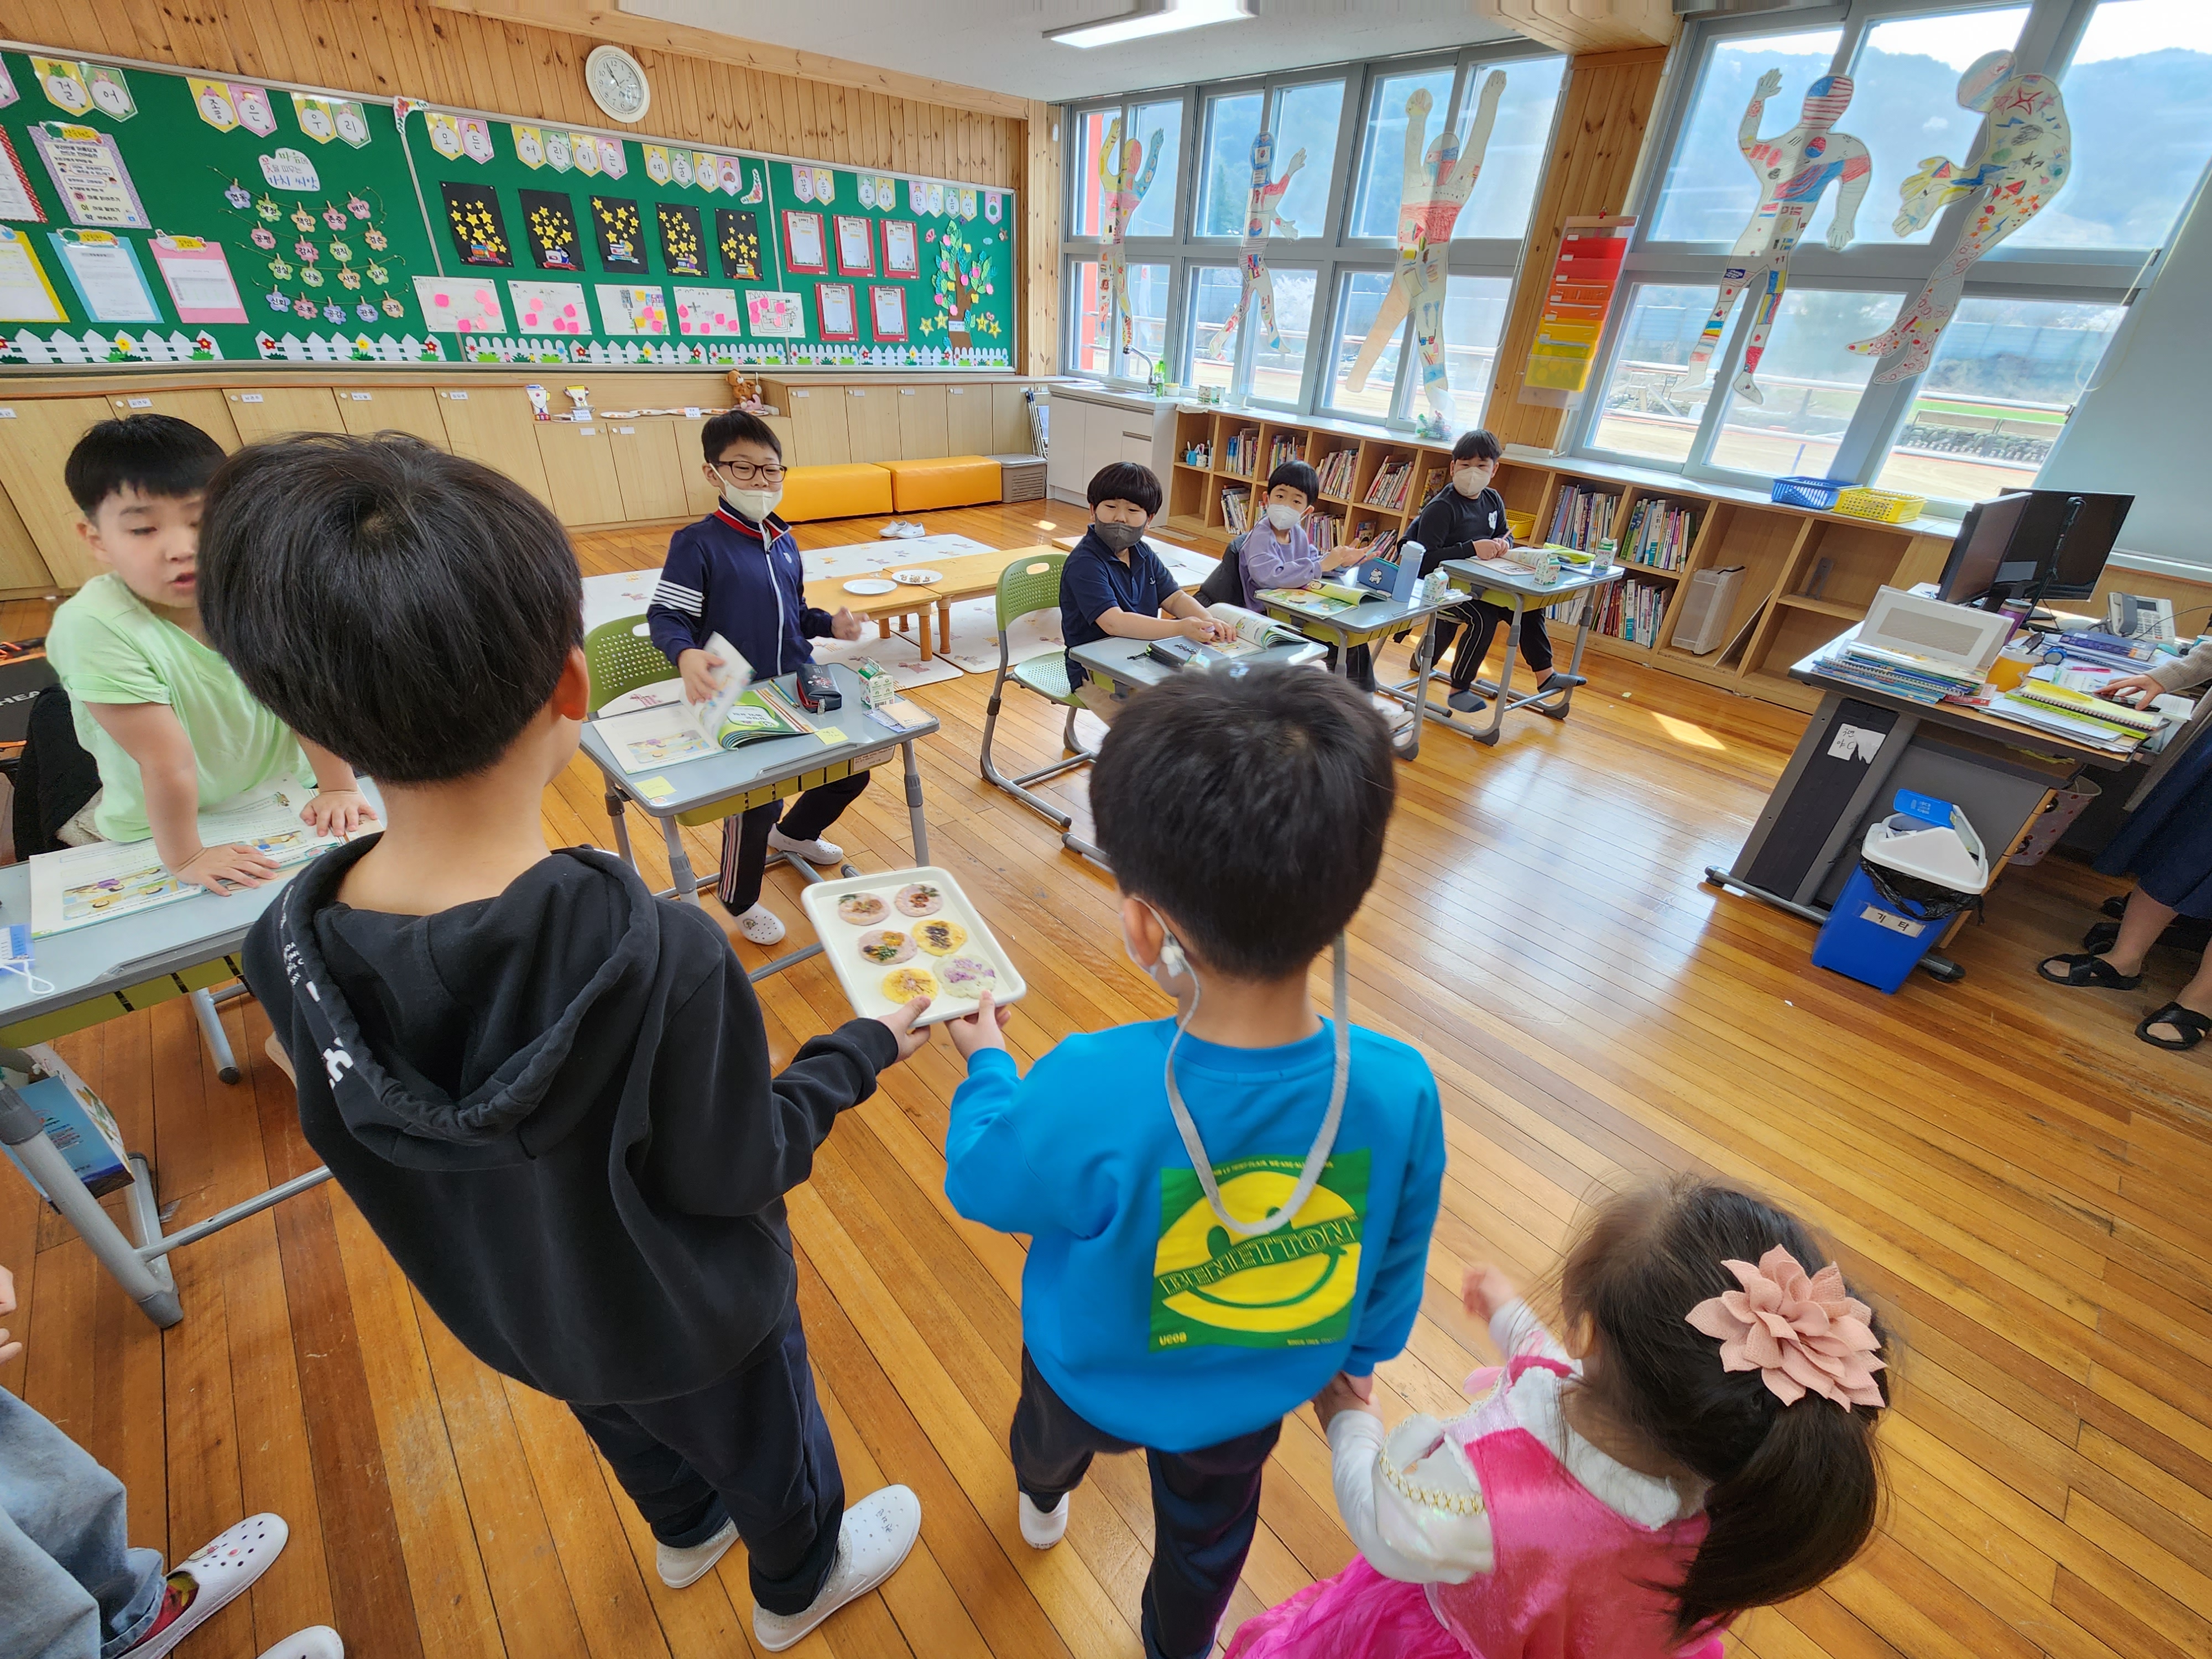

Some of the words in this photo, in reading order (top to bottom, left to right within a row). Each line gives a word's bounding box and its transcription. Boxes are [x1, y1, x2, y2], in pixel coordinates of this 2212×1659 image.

[268, 174, 290, 186] 가치
[295, 176, 319, 189] 씨앗
[231, 192, 247, 202] 협동
[261, 204, 276, 215] 예절
[296, 217, 311, 226] 책임
[328, 215, 343, 224] 존중
[255, 233, 271, 243] 공평
[300, 247, 315, 255] 감사
[333, 247, 348, 256] 정직
[274, 264, 289, 274] 성실
[372, 268, 386, 278] 질서
[343, 274, 357, 283] 사랑
[1656, 513, 1662, 523] 사회
[1158, 1214, 1358, 1296] BENETTON
